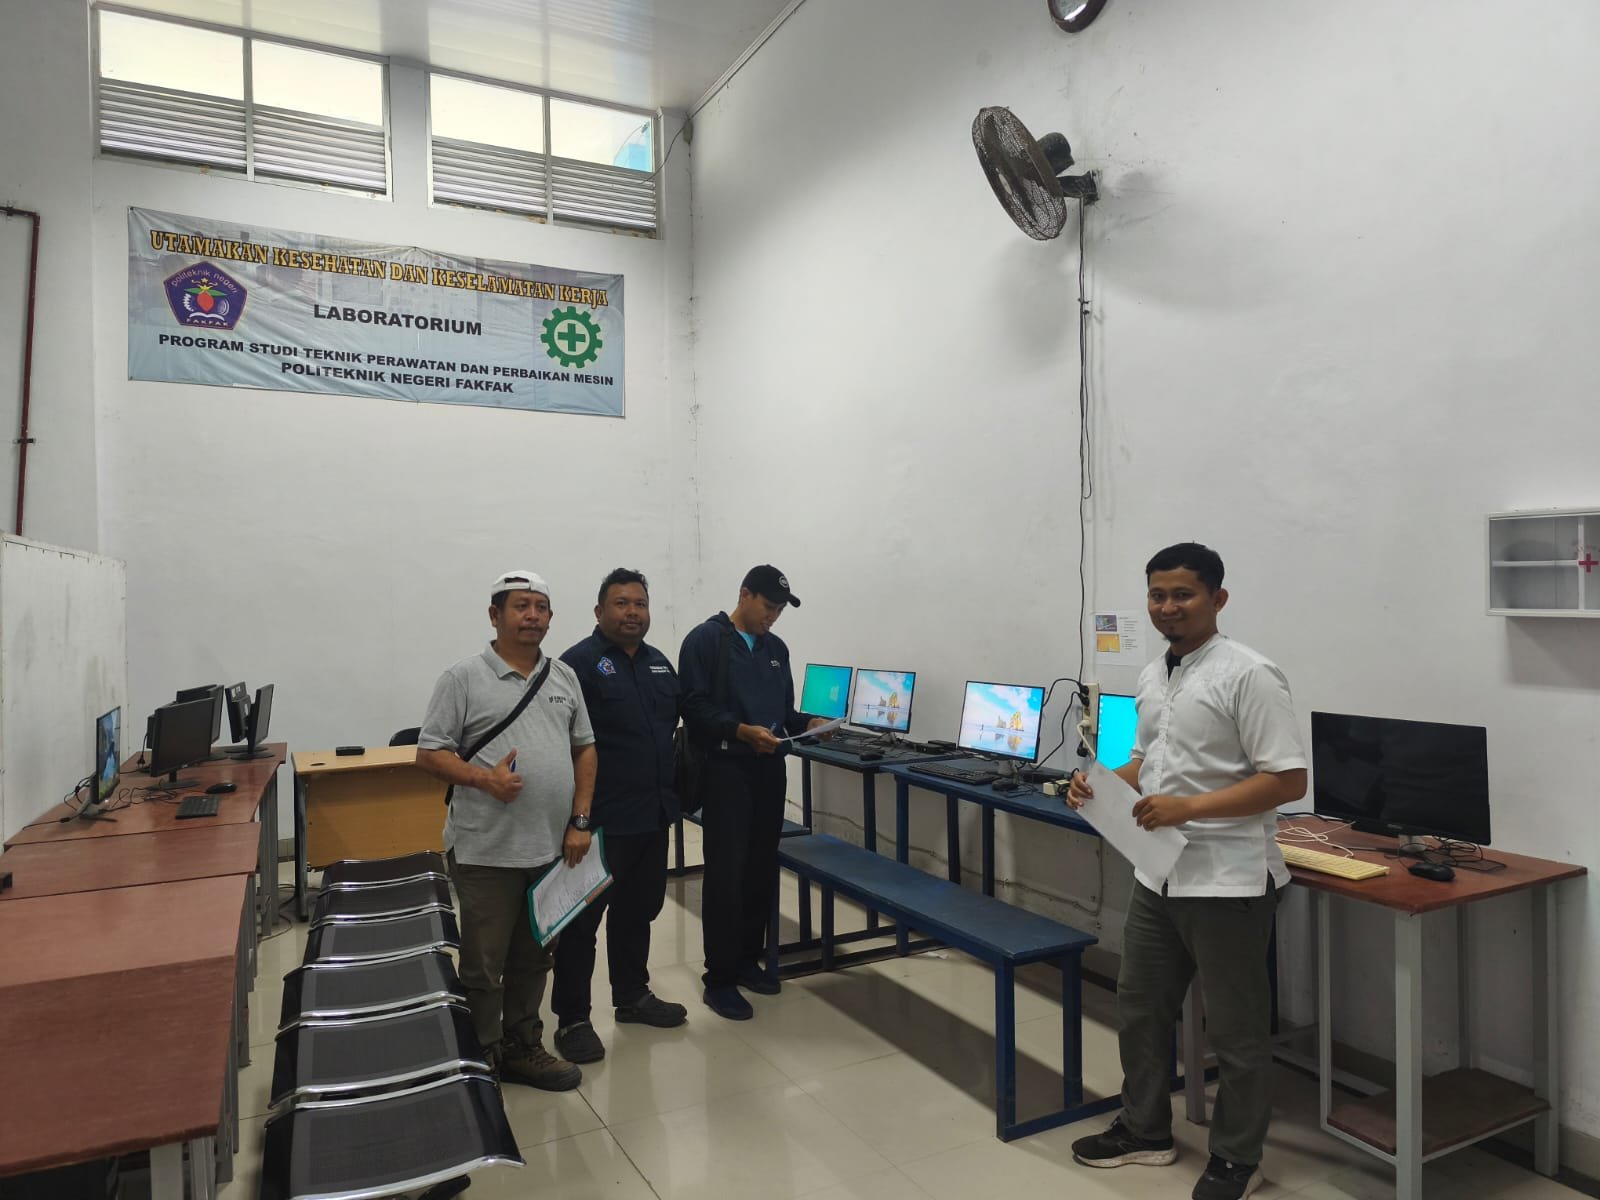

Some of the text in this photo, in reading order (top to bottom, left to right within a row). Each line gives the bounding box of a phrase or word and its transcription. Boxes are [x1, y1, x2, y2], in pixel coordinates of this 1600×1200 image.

[150, 229, 609, 309] UTAMAKAN KESEHATAN DAN KESELAMATAN KERJA
[171, 268, 238, 294] politeknik negeri
[314, 304, 482, 336] LABORATORIUM
[159, 334, 614, 386] PROGRAM STUDI TEKNIK PERAWATAN DAN PERBAIKAN MESIN
[281, 362, 514, 393] POLITEKNIK NEGERI FAKFAK
